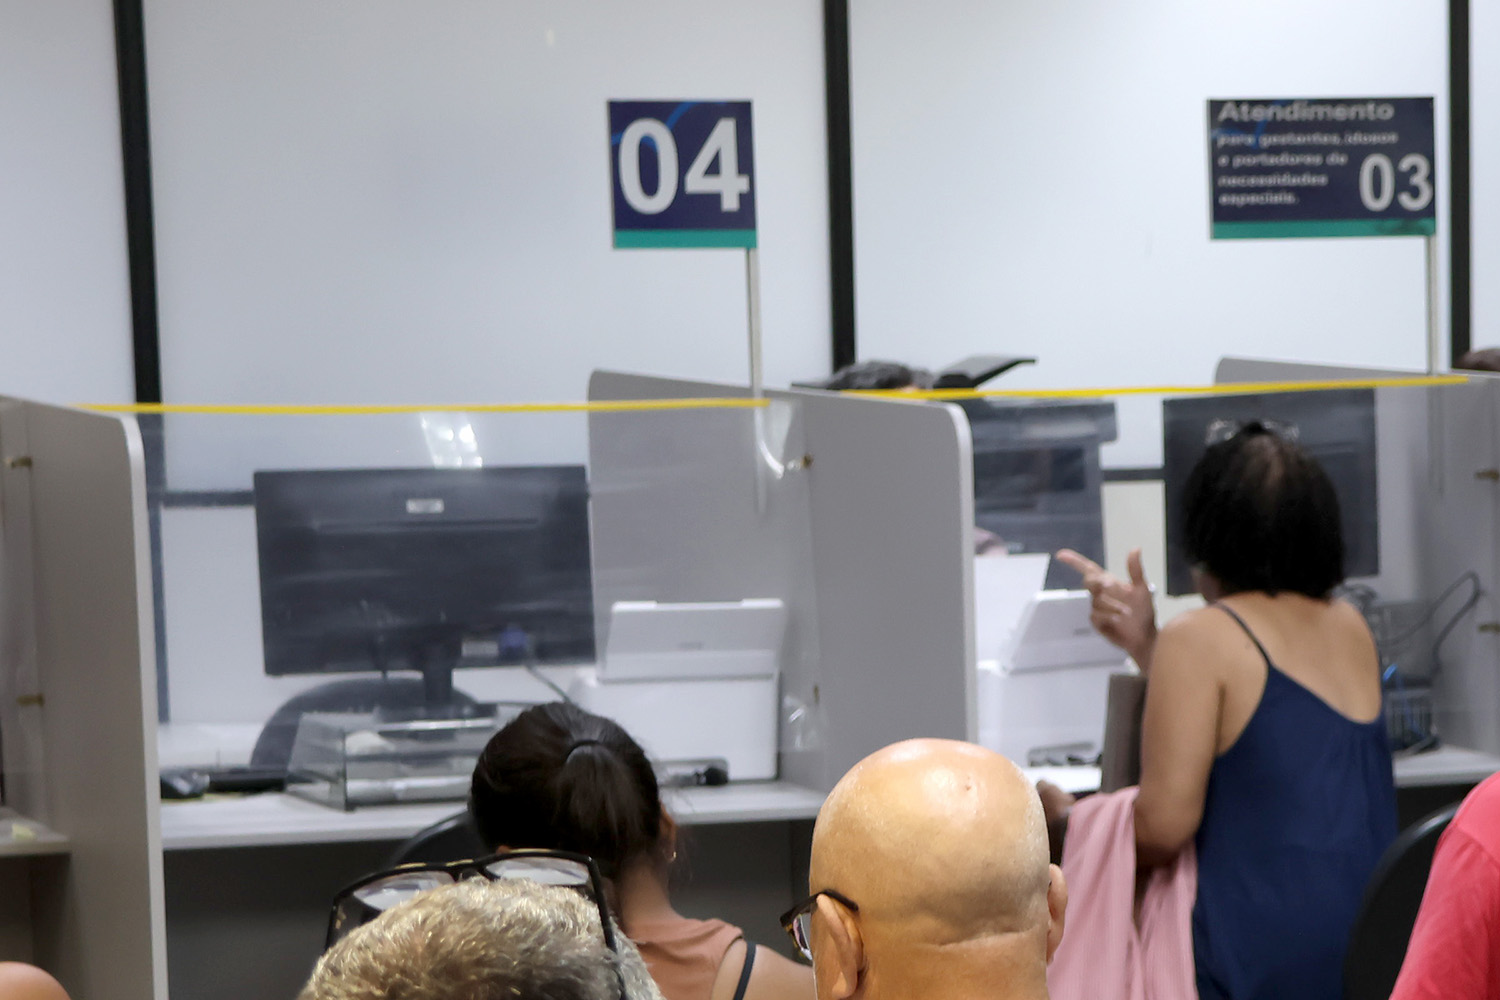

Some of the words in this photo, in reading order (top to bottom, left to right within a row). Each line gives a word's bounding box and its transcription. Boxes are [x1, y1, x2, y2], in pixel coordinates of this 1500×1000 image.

[1218, 100, 1395, 121] Atendimento
[618, 117, 750, 215] 04
[1359, 152, 1433, 212] 03
